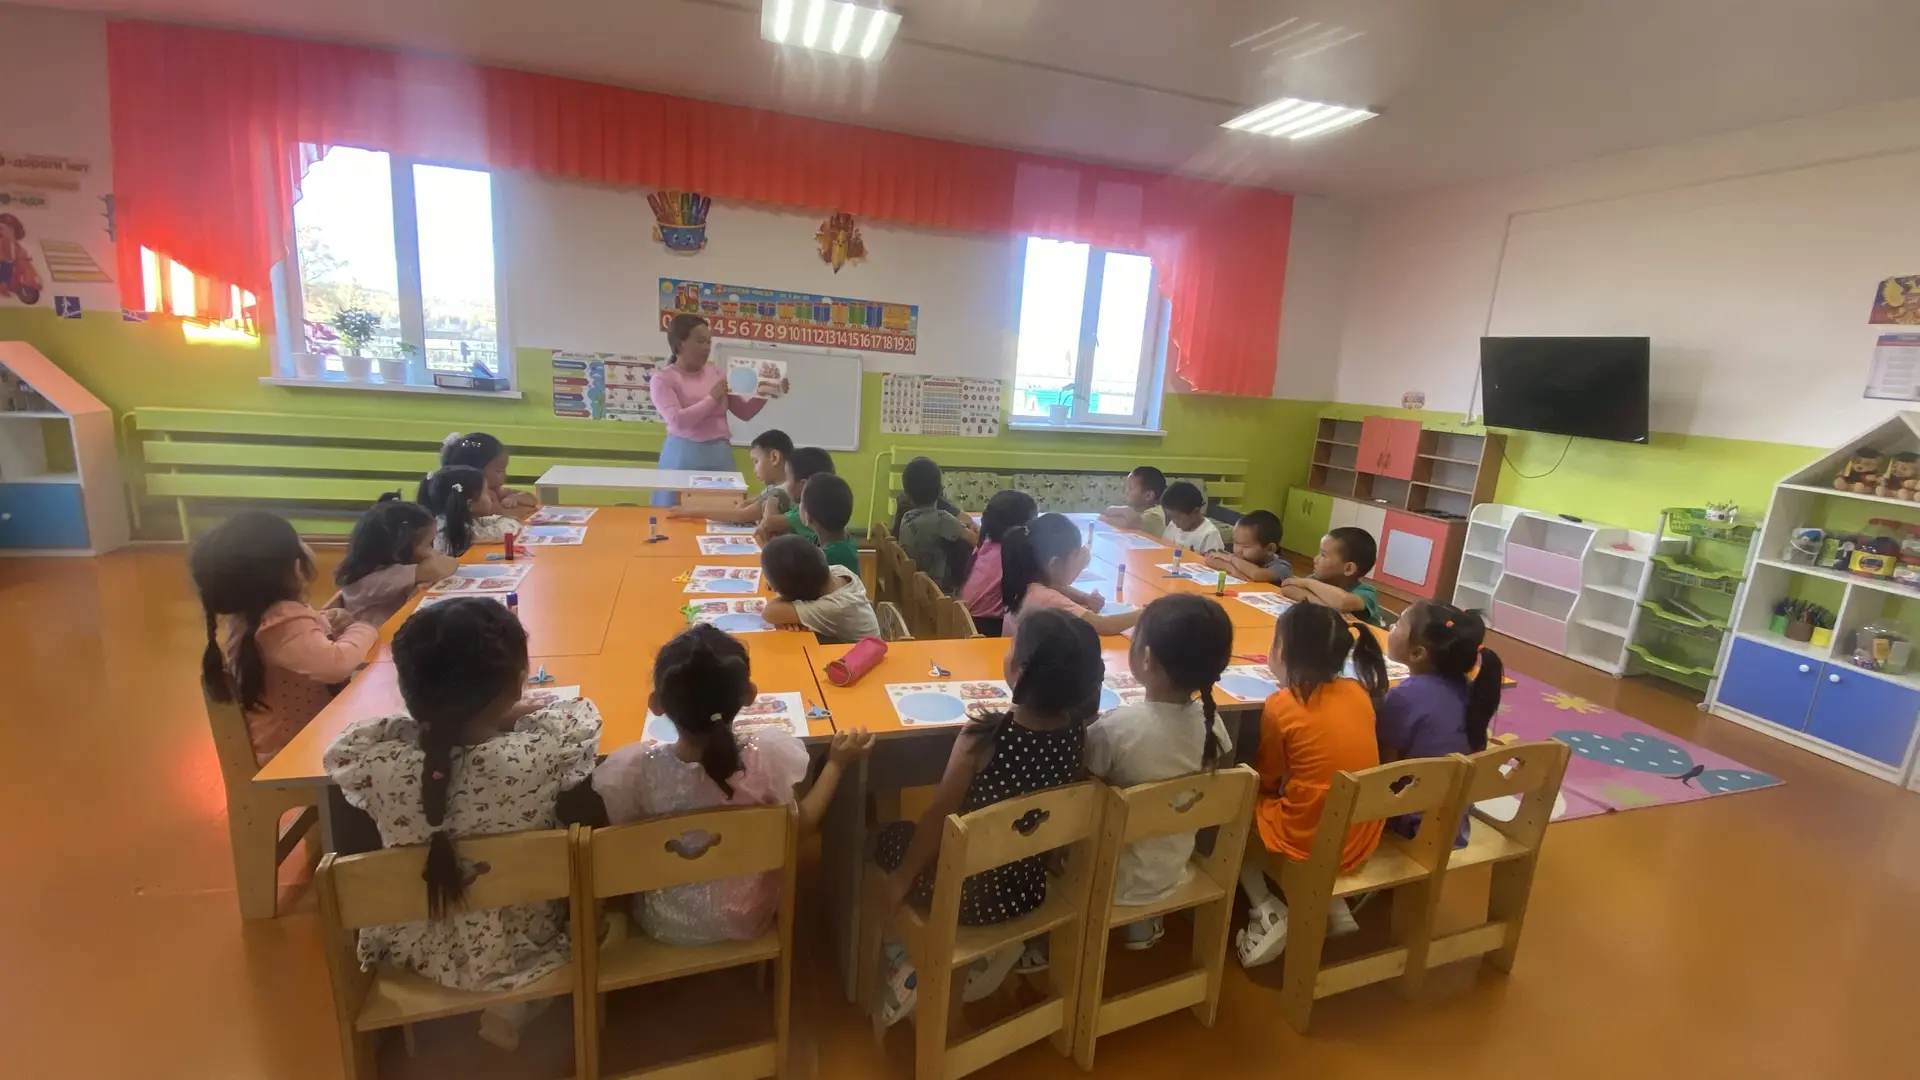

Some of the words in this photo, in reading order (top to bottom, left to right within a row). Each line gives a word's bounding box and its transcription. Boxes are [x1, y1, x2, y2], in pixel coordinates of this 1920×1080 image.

[714, 319, 725, 334] 4
[727, 320, 737, 335] 5
[739, 321, 750, 336] 6
[751, 323, 762, 337] 7
[764, 323, 775, 339] 8
[777, 324, 788, 340] 9
[789, 326, 800, 341] 10
[801, 327, 812, 342] 11
[812, 328, 825, 344] 12
[824, 329, 835, 345] 13
[835, 331, 847, 346] 14
[847, 332, 859, 347] 15
[859, 333, 871, 348] 16
[870, 334, 882, 349] 17
[882, 335, 893, 350] 18
[893, 336, 904, 351] 19
[904, 337, 916, 352] 20
